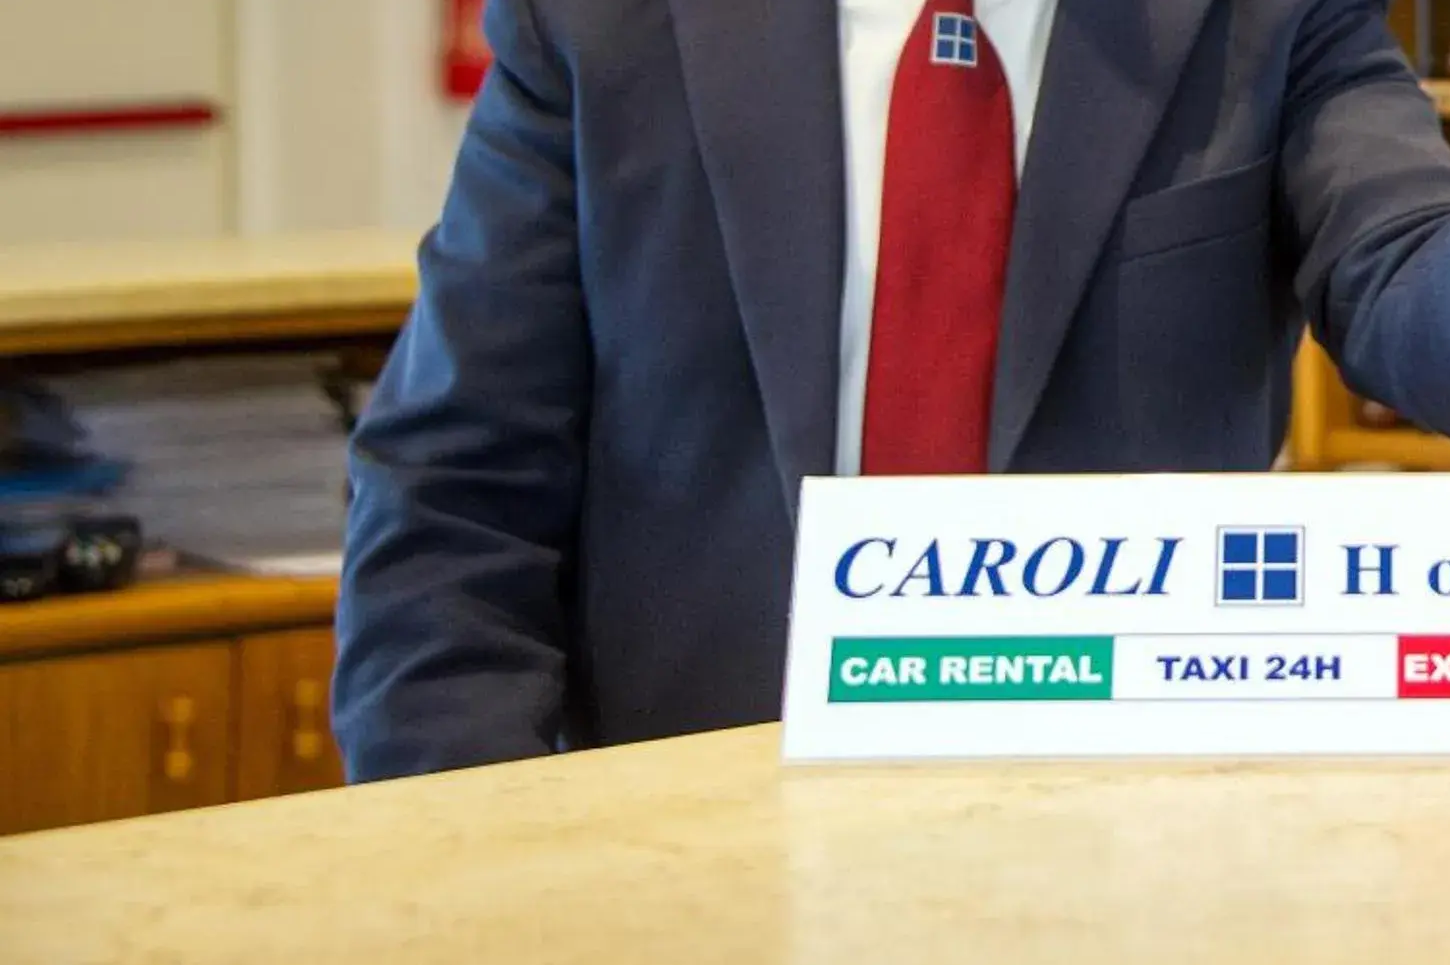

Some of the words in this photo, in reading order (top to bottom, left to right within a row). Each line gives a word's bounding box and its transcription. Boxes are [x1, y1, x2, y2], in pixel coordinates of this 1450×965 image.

[833, 536, 1181, 600] CAROLI
[839, 656, 925, 684] CAR
[939, 654, 1102, 684] RENTAL
[1155, 655, 1250, 682] TAXI
[1264, 654, 1342, 681] 24H
